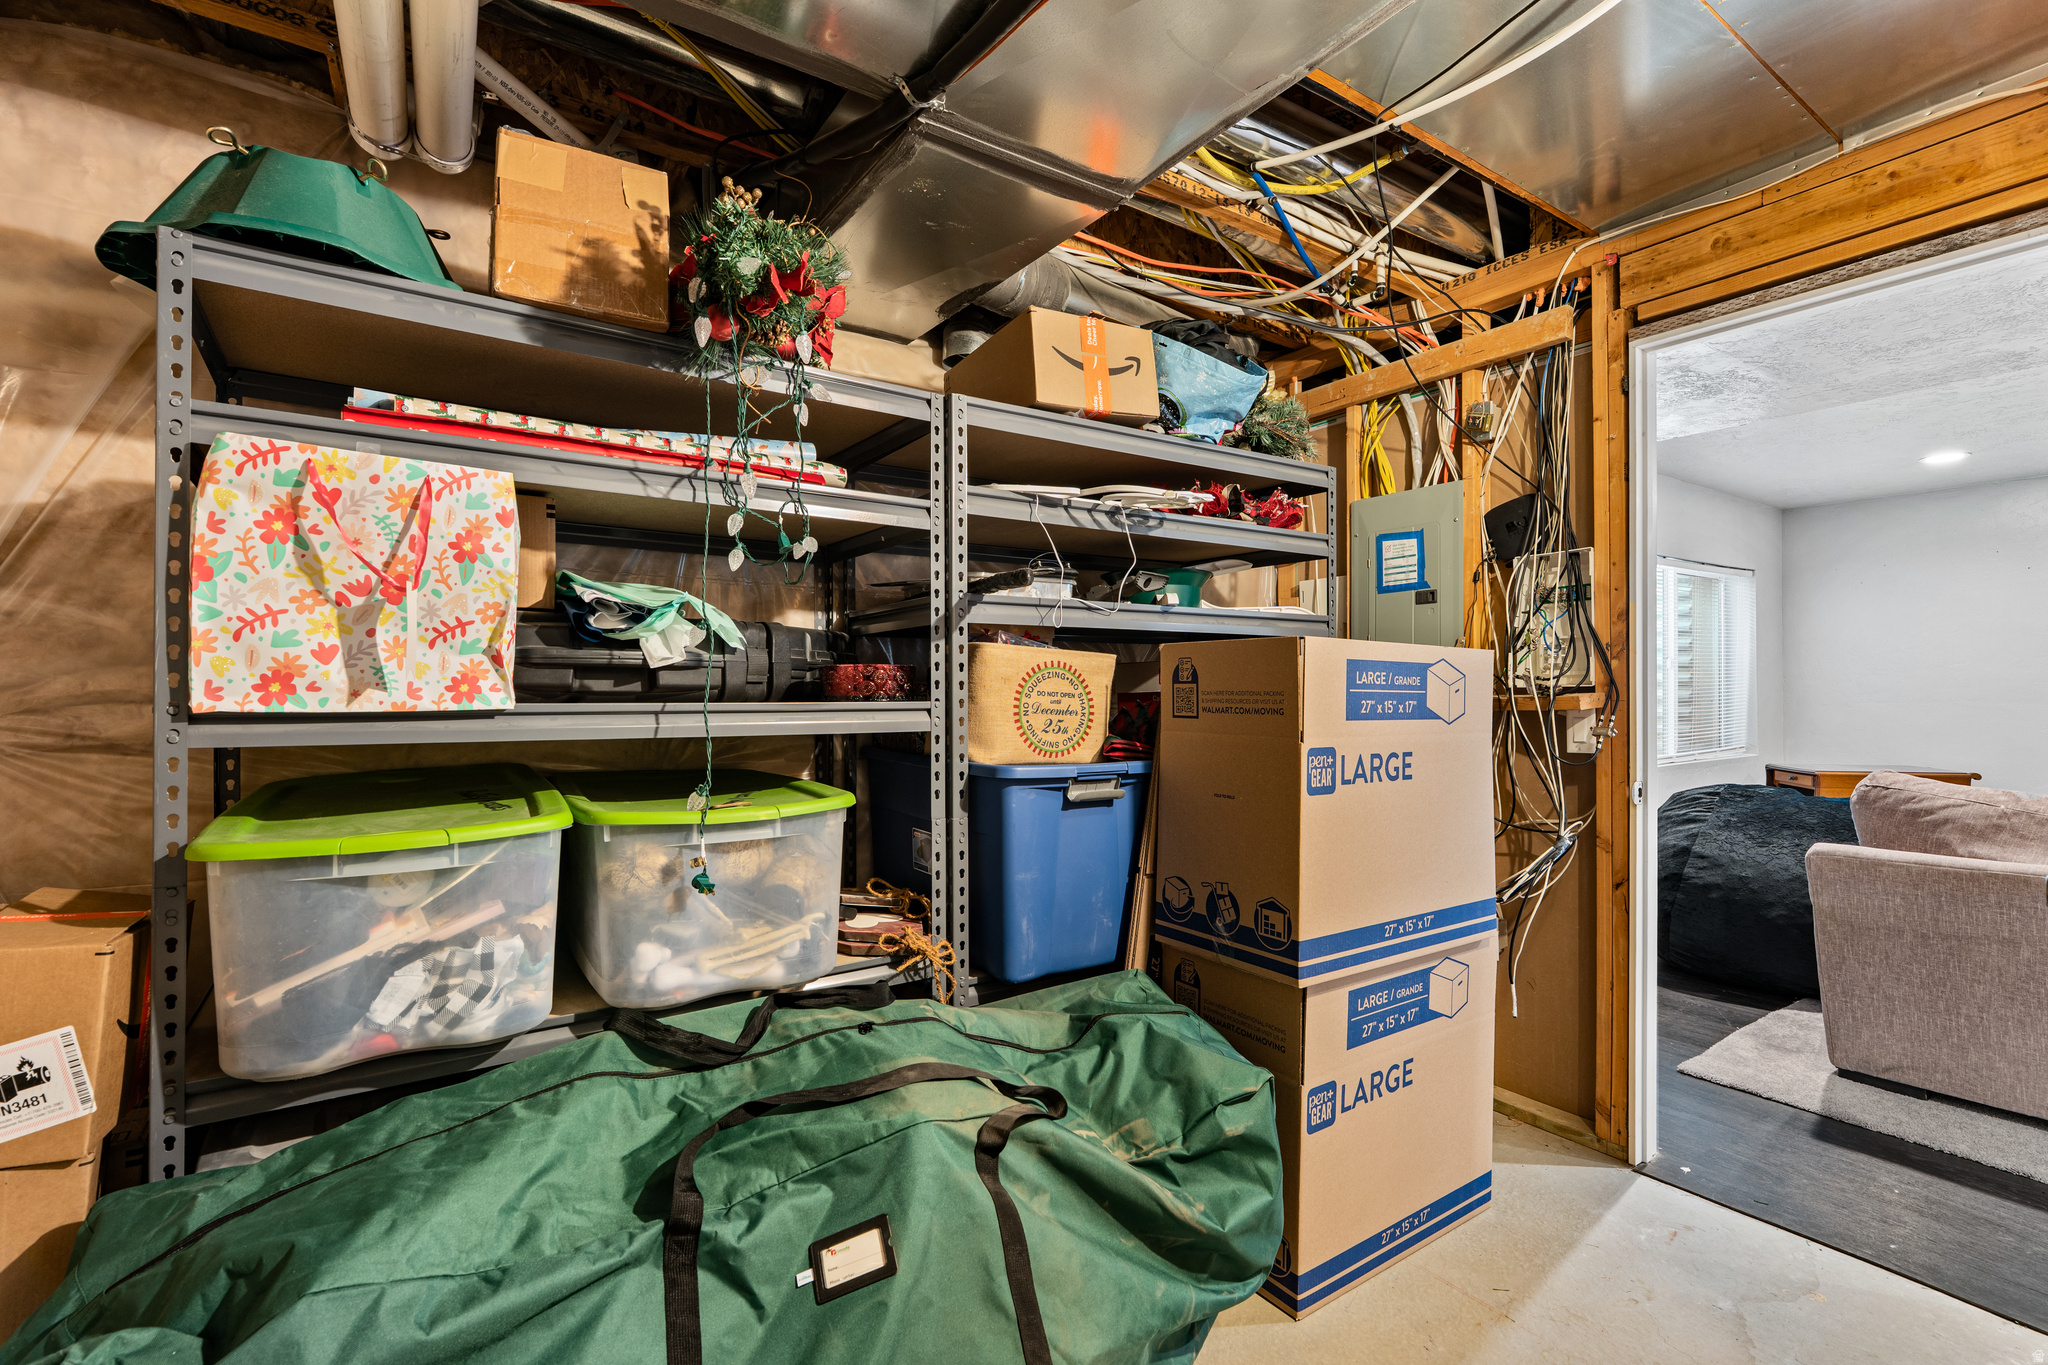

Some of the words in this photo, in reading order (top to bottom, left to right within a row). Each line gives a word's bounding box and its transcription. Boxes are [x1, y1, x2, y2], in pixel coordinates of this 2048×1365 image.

[1356, 671, 1386, 685] LARGE
[1393, 676, 1421, 686] GRANDE
[1022, 702, 1030, 717] NO
[1031, 701, 1079, 717] December
[1201, 706, 1285, 716] WALMART.COM/MOVING
[1361, 700, 1375, 714] 27"
[1384, 700, 1397, 714] 15"
[1405, 700, 1417, 714] 17"
[1041, 718, 1069, 735] 25th
[1311, 768, 1332, 788] GEAR
[1341, 751, 1413, 786] LARGE
[1384, 923, 1397, 937] 27"
[1405, 918, 1417, 932] 15"
[1424, 915, 1435, 928] 17"
[1357, 990, 1389, 1012] LARGE
[1396, 983, 1424, 999] GRANDE
[1361, 1021, 1377, 1038] 27"
[1385, 1014, 1398, 1029] 15"
[1407, 1006, 1420, 1022] 17"
[1340, 1057, 1414, 1114] LARGE
[0, 1093, 47, 1117] N3481
[1311, 1101, 1332, 1126] GEAR
[1381, 1228, 1394, 1245] 27"
[1401, 1217, 1413, 1233] 15"
[1420, 1207, 1431, 1223] 17"
